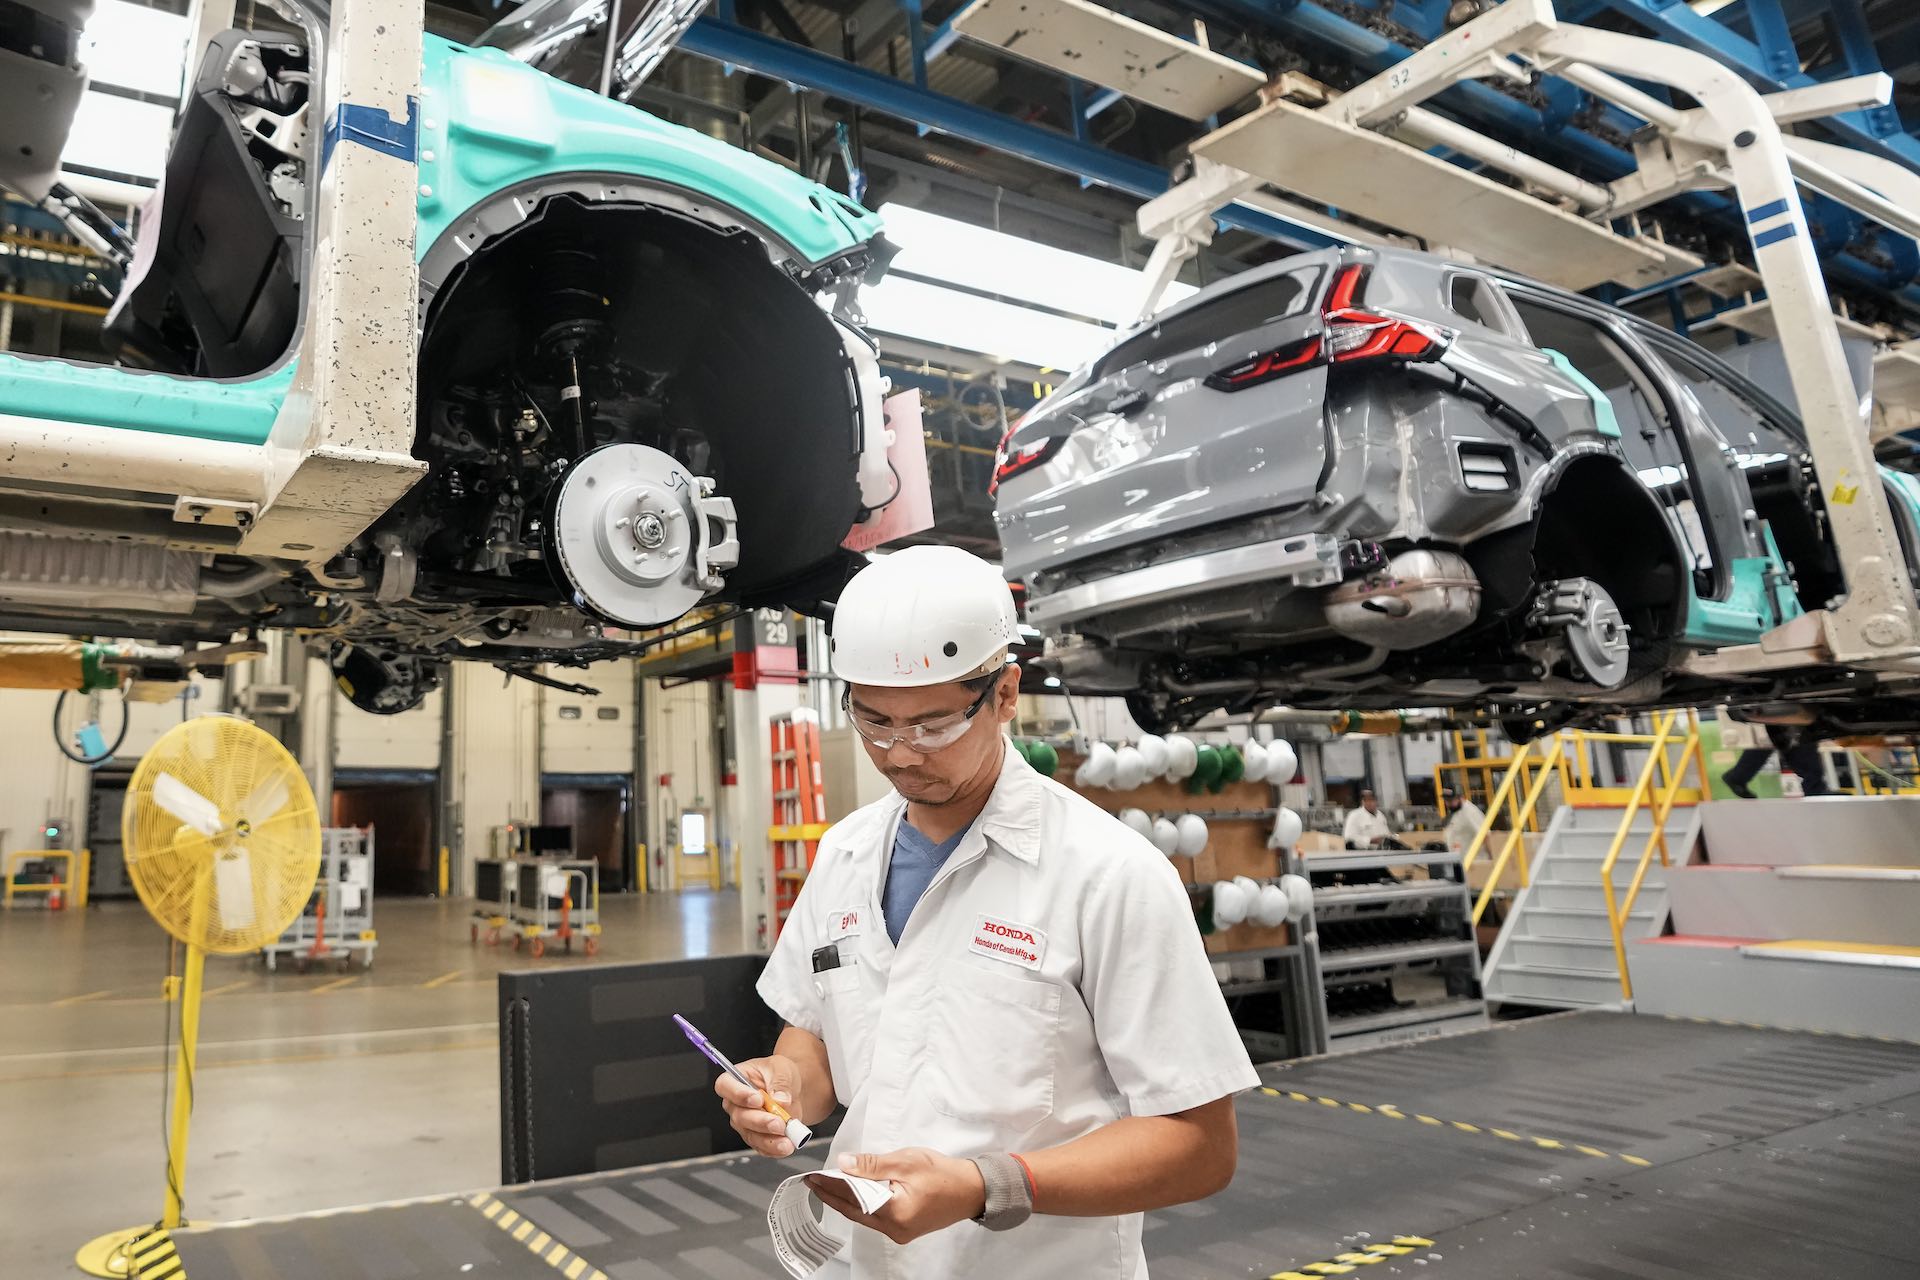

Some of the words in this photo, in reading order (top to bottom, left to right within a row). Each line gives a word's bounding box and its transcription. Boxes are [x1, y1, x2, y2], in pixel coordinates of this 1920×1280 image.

[766, 622, 788, 645] 29
[974, 935, 993, 949] Honda
[992, 942, 1000, 951] of
[982, 921, 1036, 945] HONDA
